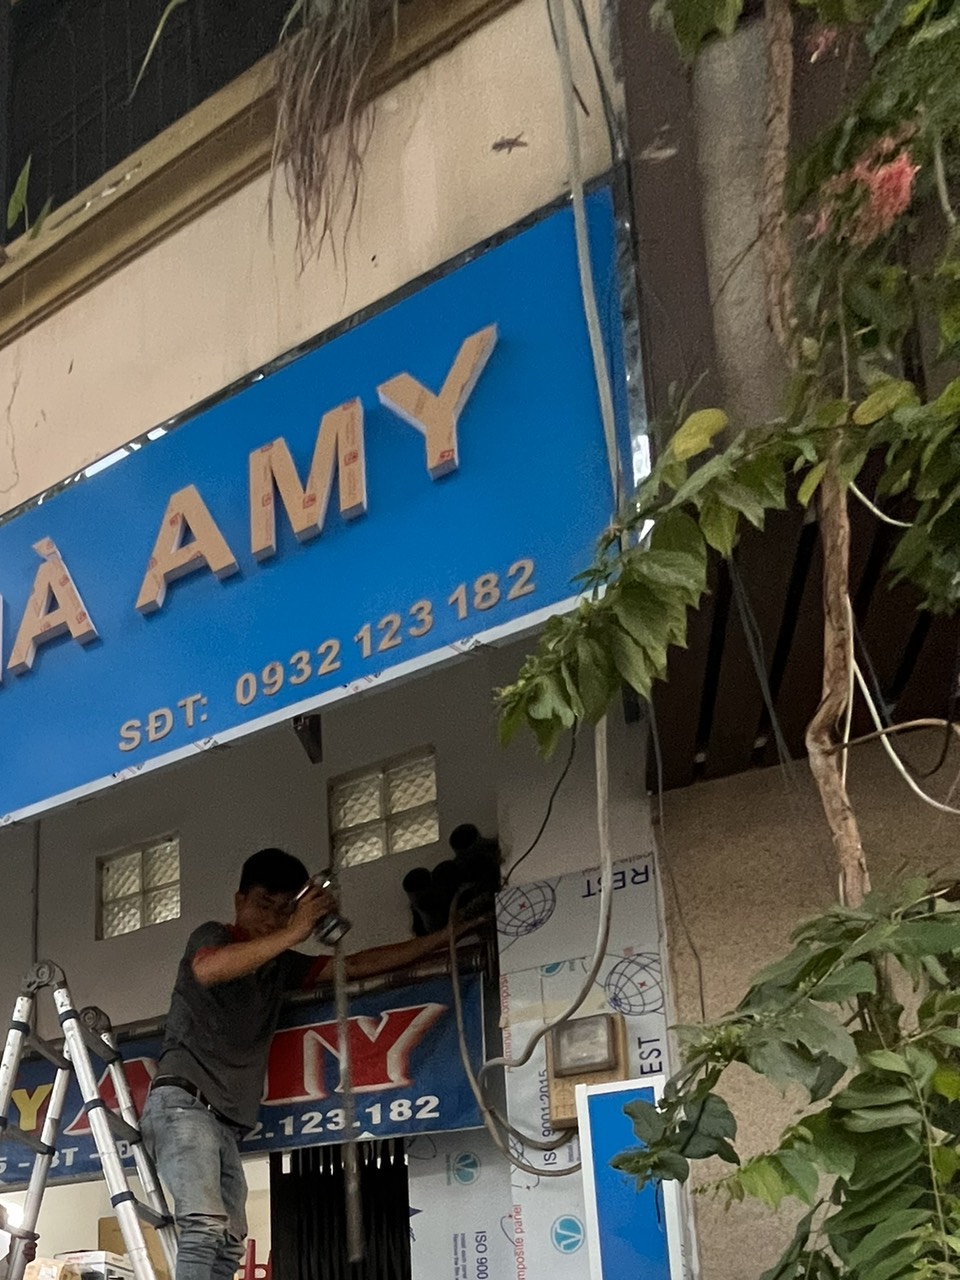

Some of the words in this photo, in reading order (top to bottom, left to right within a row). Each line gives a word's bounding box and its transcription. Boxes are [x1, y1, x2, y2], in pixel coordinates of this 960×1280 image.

[135, 322, 499, 616] AMY
[118, 693, 209, 752] SĐT:
[235, 639, 342, 706] 0932
[354, 600, 435, 659] 123
[448, 558, 537, 620] 182
[475, 1231, 487, 1253] ISO
[513, 1204, 523, 1234] panel
